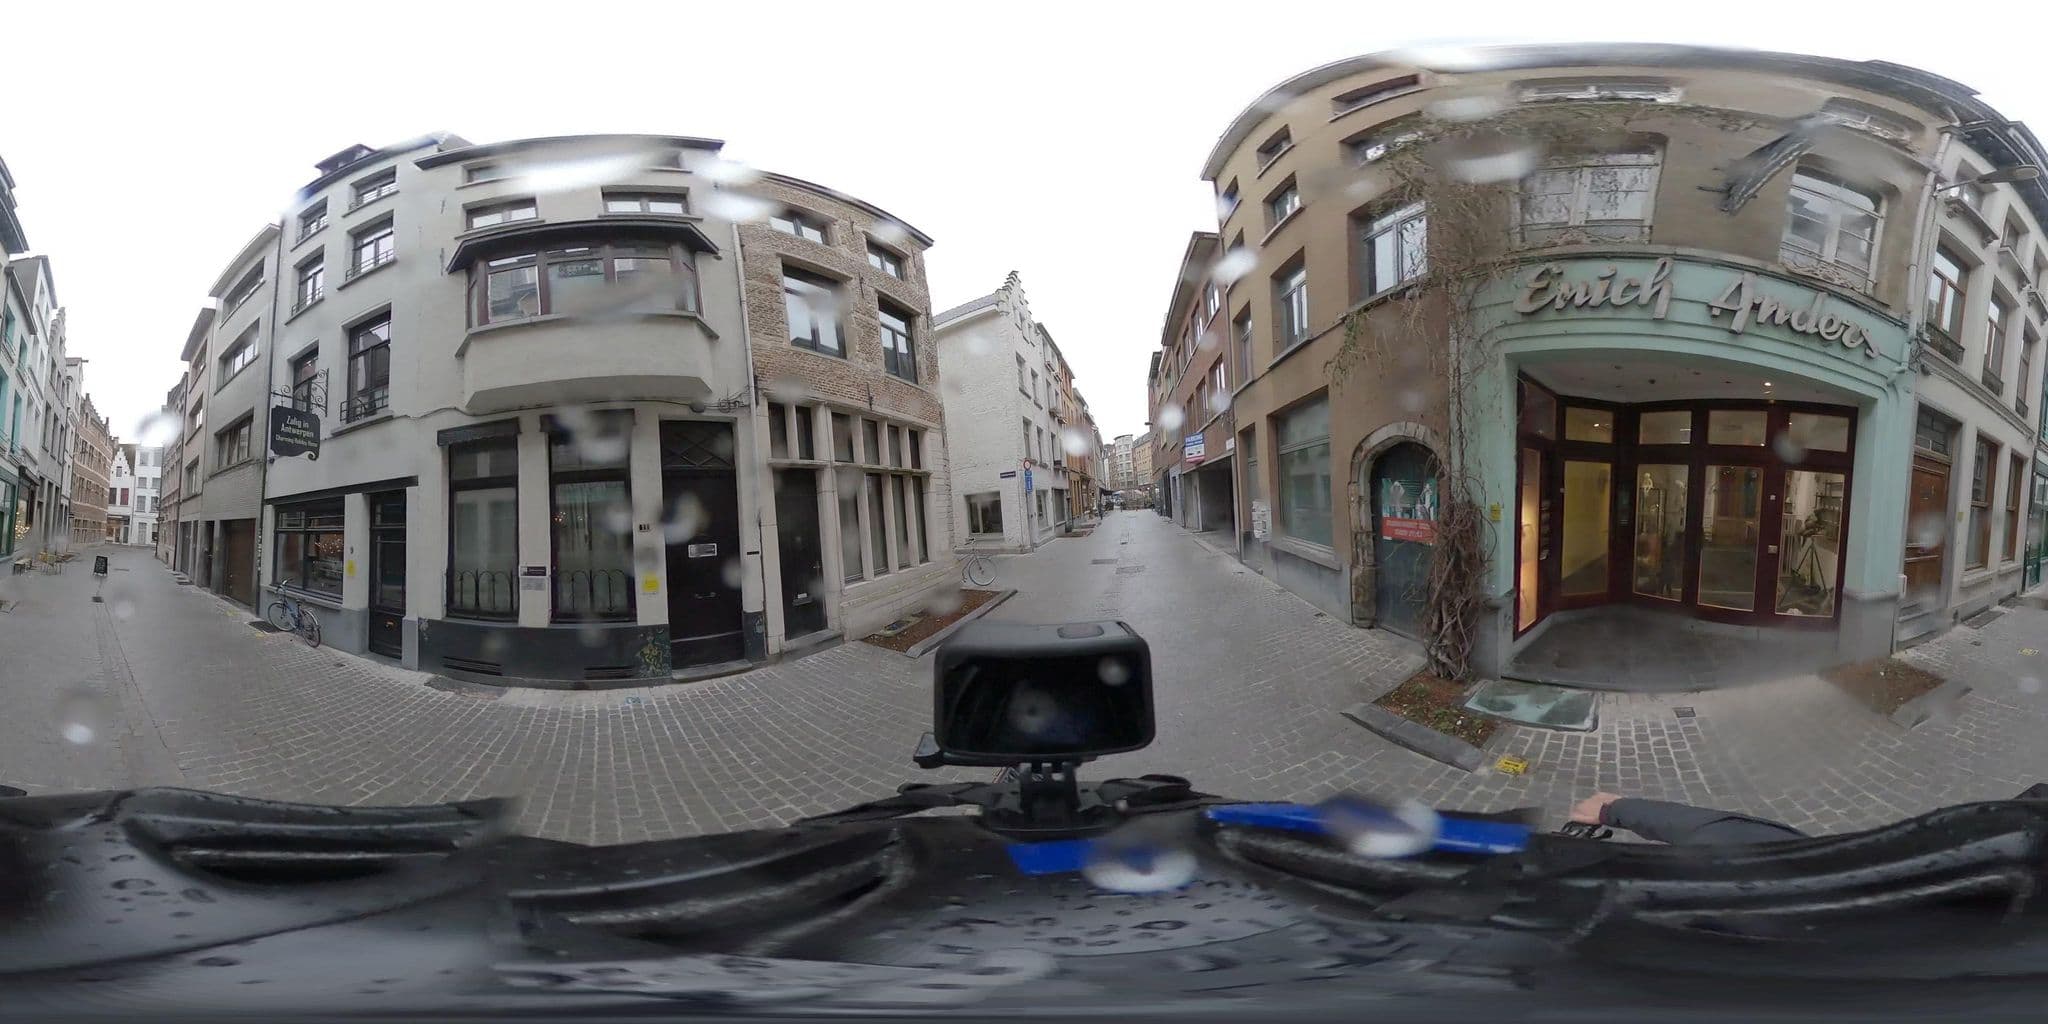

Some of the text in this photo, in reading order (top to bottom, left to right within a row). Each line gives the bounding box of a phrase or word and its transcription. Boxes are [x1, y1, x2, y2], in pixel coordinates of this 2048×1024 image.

[1513, 257, 1881, 359] Erich Anders
[286, 415, 309, 428] Zalig in
[280, 423, 314, 438] Antwerpen
